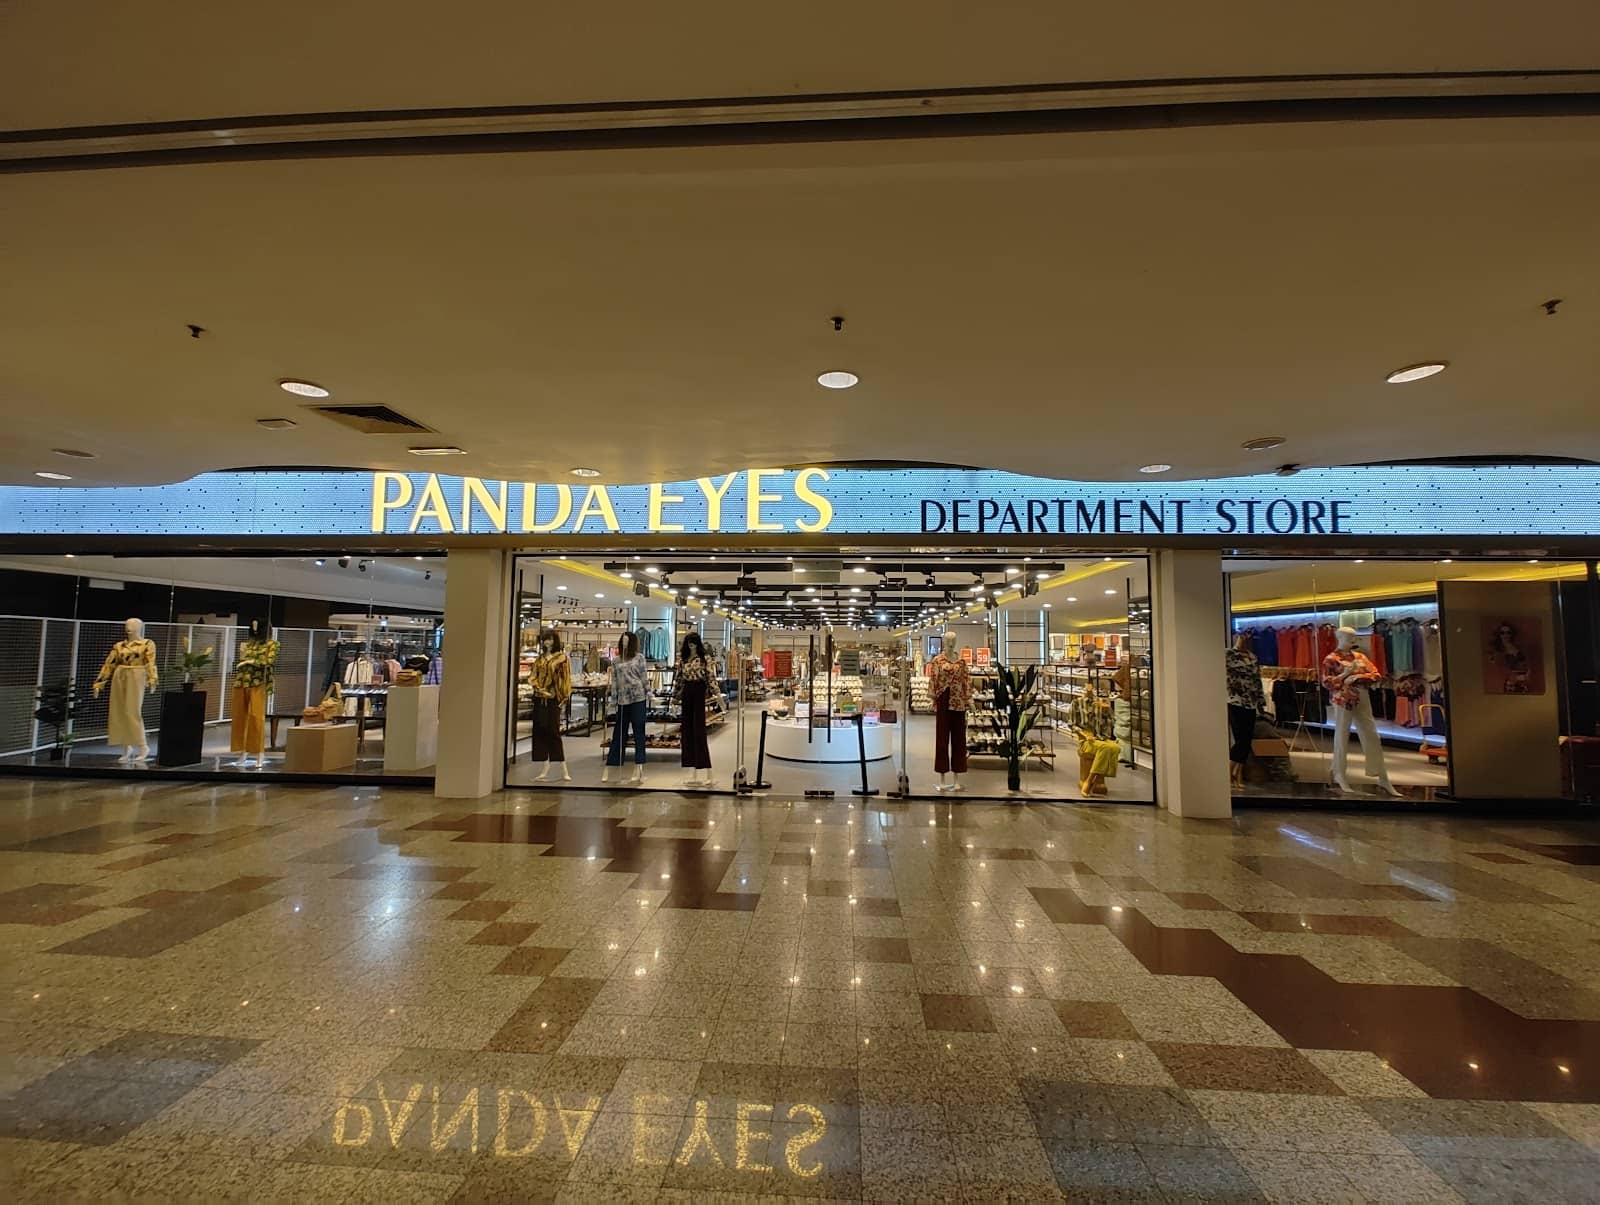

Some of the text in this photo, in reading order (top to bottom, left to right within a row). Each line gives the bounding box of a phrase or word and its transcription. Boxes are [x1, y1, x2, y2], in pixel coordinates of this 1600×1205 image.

[371, 467, 834, 533] PANDA EYES
[920, 499, 1353, 535] DEPARTMENT STORE
